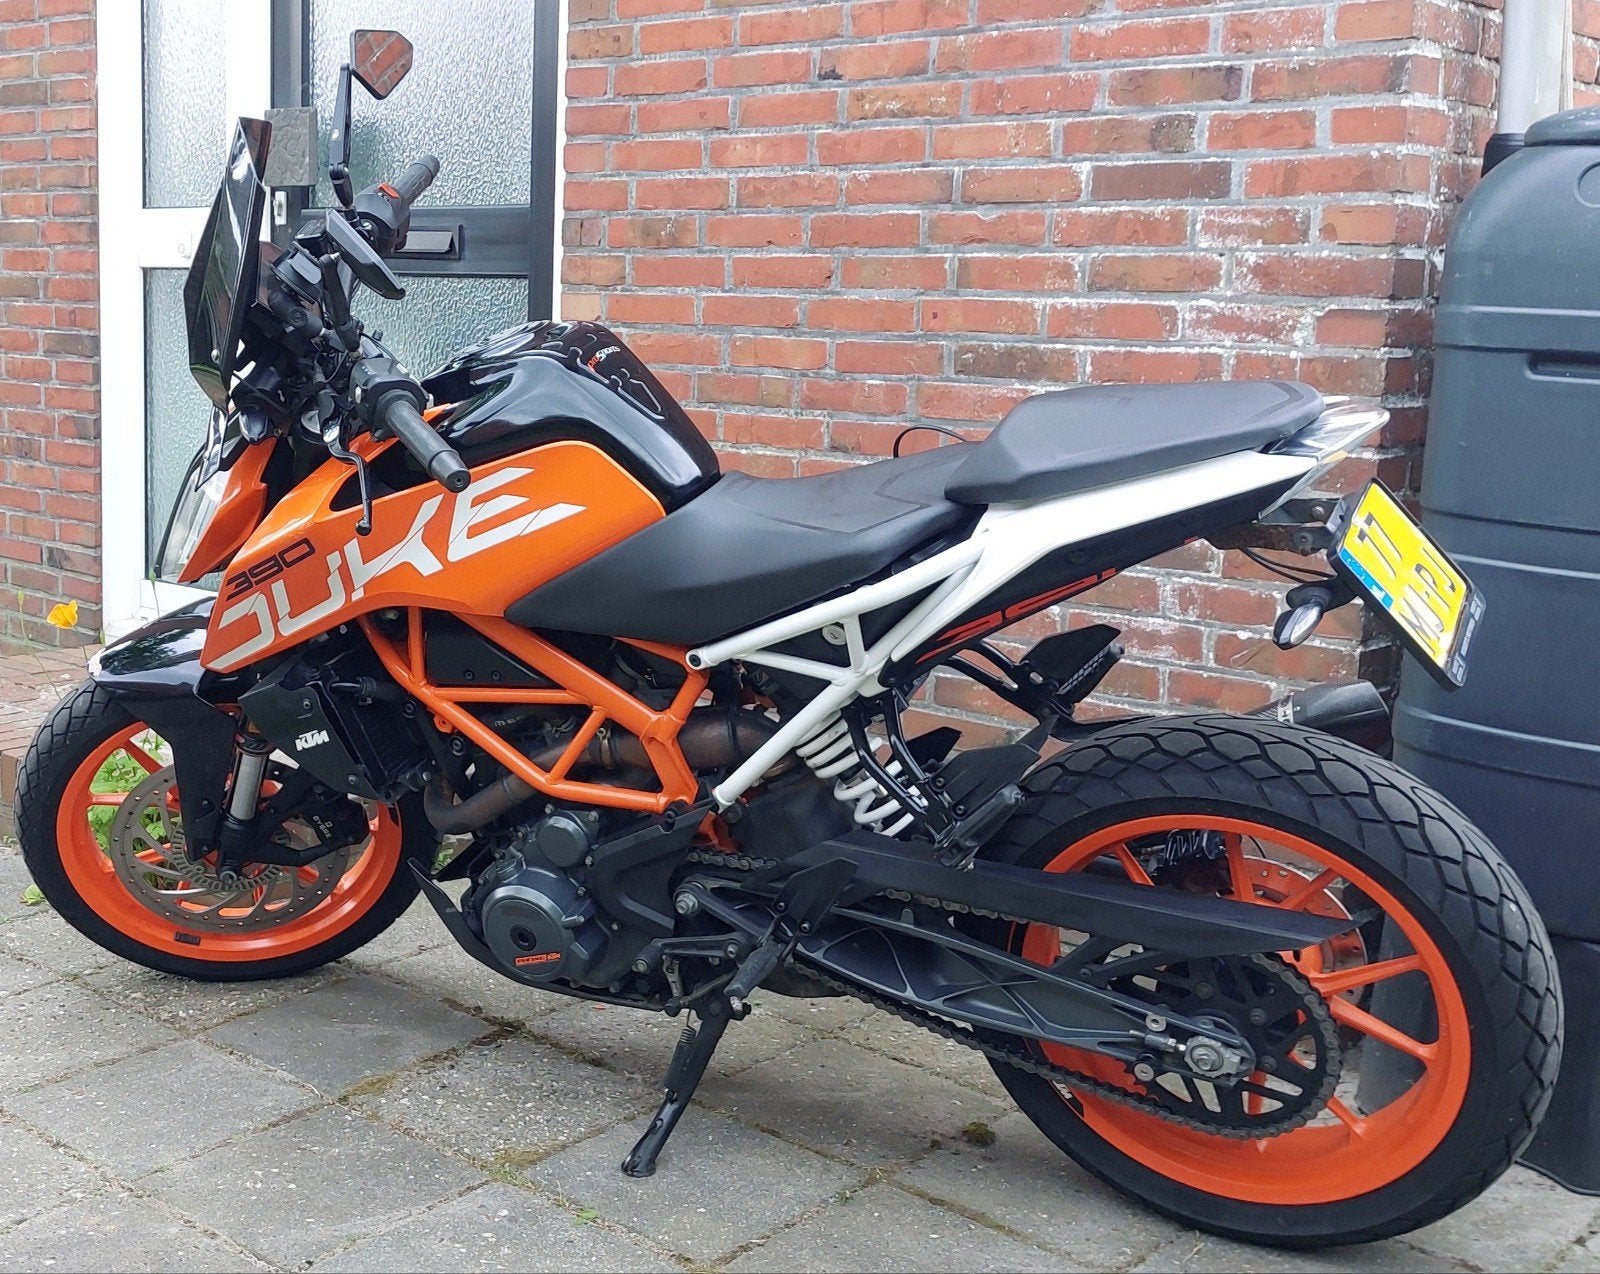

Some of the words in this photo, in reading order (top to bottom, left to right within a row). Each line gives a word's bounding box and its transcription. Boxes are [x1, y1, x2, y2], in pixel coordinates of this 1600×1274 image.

[206, 467, 588, 671] DUKE
[226, 538, 316, 602] 390
[1357, 511, 1403, 578] 77
[294, 729, 331, 752] KTM
